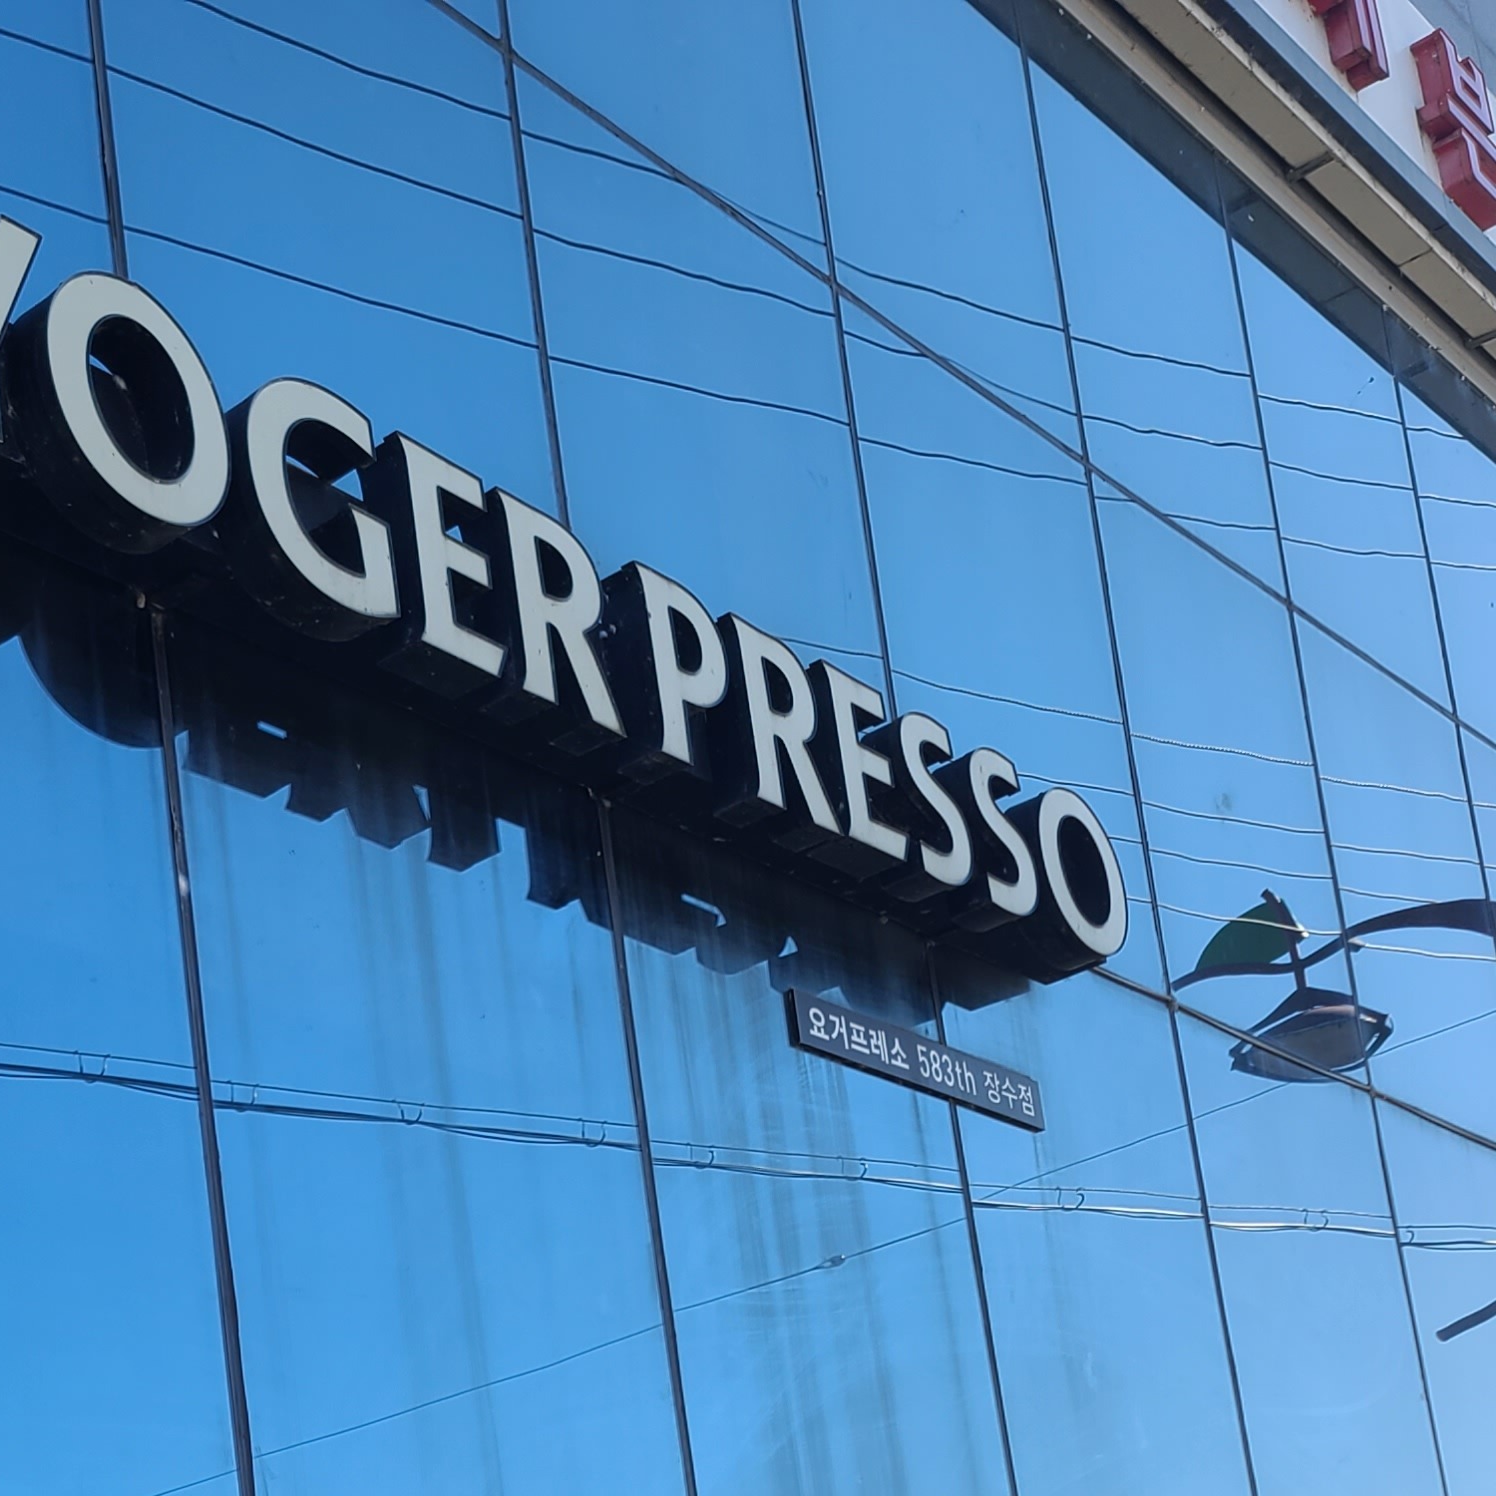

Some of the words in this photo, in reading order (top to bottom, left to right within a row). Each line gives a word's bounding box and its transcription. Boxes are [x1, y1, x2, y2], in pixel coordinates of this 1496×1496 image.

[632, 560, 1128, 956] PRESSO
[808, 1007, 910, 1070] 요거프레소
[916, 1043, 977, 1096] 583th
[983, 1070, 1036, 1117] 장수점
